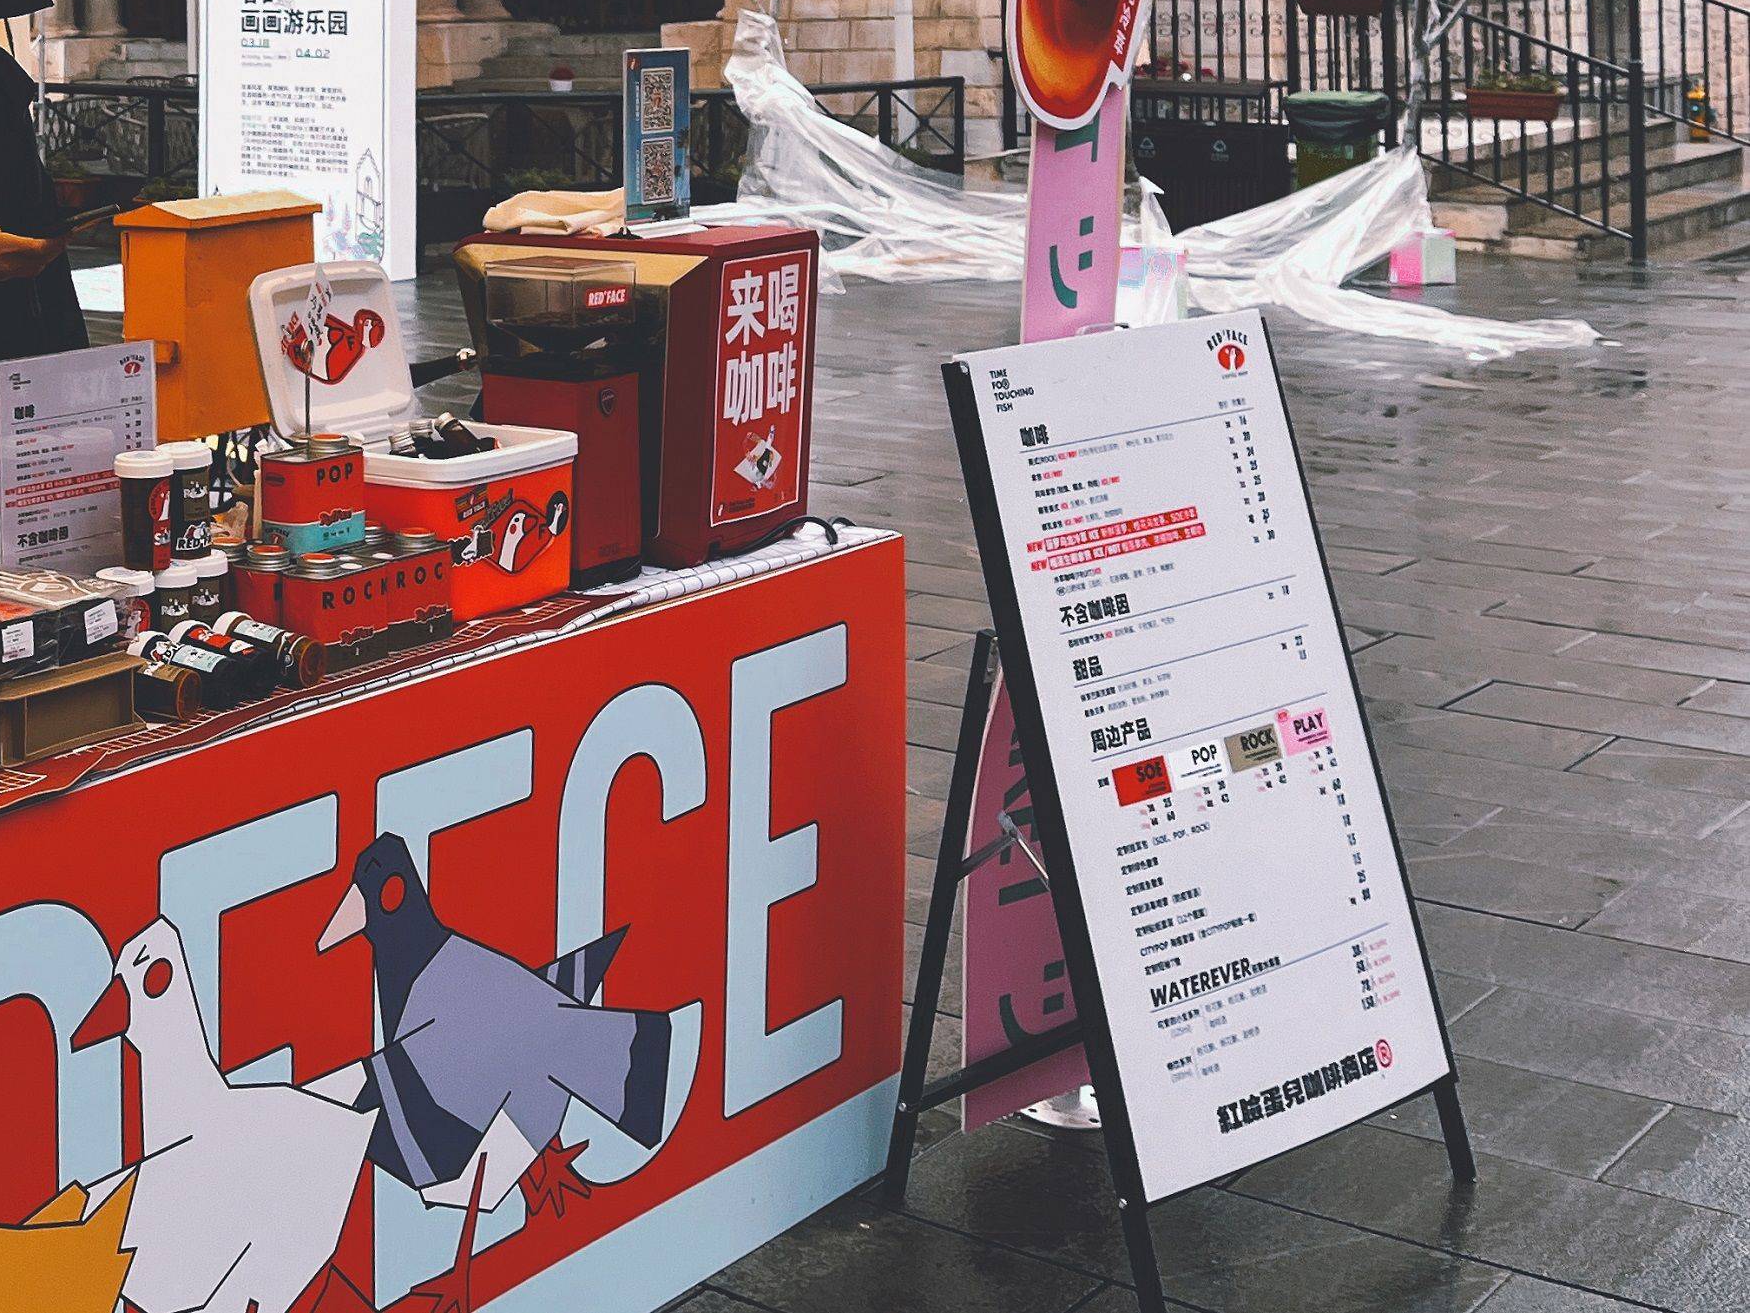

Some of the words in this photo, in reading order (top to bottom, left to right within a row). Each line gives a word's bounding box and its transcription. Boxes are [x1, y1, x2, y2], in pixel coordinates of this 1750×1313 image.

[241, 9, 348, 35] 画画游乐园
[725, 263, 800, 345] 来喝
[723, 340, 797, 426] 咖啡
[316, 462, 353, 485] POP
[1090, 717, 1152, 753] 周边产品
[1191, 744, 1218, 765] POP
[1240, 728, 1277, 752] ROCK
[1293, 712, 1324, 735] PLAY
[1150, 956, 1251, 1008] WATEREVER
